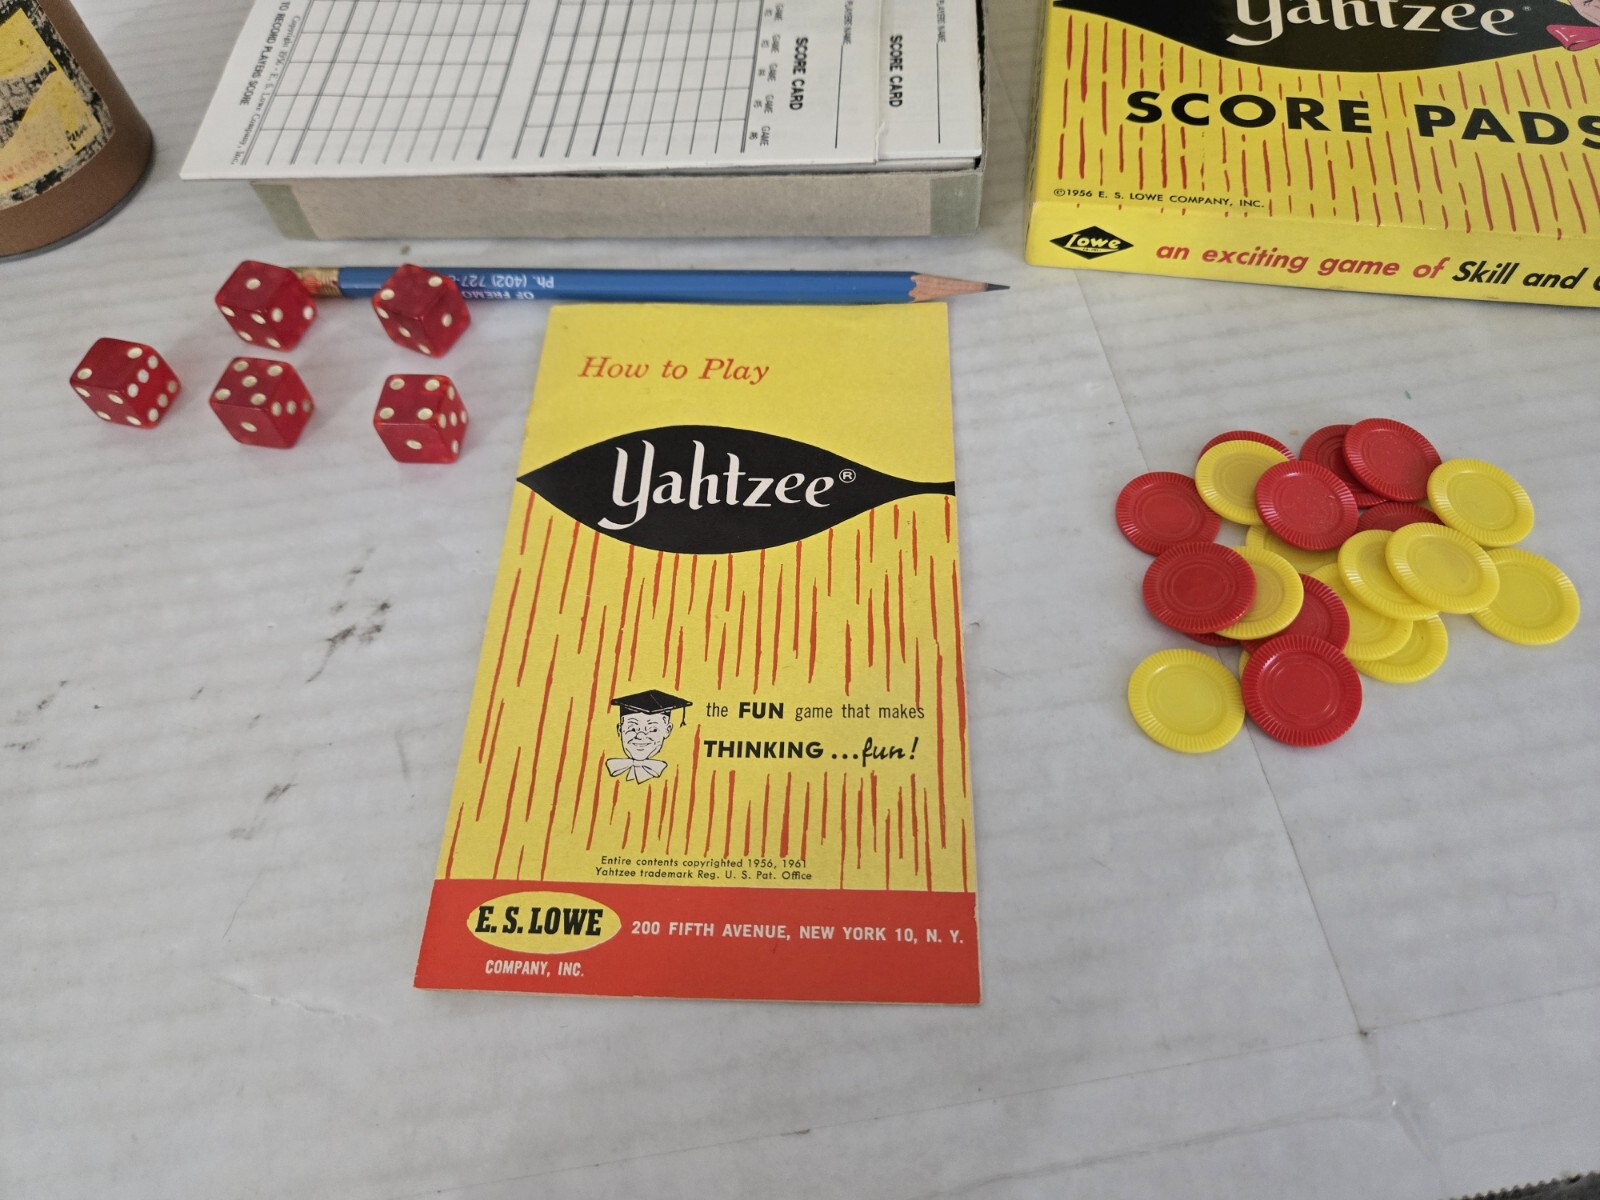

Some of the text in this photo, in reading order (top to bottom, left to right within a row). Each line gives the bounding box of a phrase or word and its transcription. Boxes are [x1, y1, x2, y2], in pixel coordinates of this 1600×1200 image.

[774, 3, 784, 21] GAME
[266, 13, 286, 44] RECORD
[771, 33, 781, 54] GAME
[767, 63, 778, 83] GAME
[789, 37, 808, 111] SCORE CARD
[889, 34, 903, 108] SCORE CARD
[239, 80, 258, 106] SCORE
[764, 94, 775, 114] GAME
[1125, 90, 1600, 150] SCORE PADS
[760, 125, 771, 146] GAME
[1098, 190, 1108, 199] E.
[1114, 191, 1124, 199] S.
[1129, 192, 1164, 202] LOWE
[1169, 195, 1233, 207] COMPANY,
[1239, 198, 1265, 208] INC.
[1065, 233, 1122, 249] Lowe
[1156, 245, 1190, 260] an
[1202, 246, 1309, 274] exciting
[1317, 257, 1400, 276] game
[1412, 256, 1451, 279] of
[1452, 260, 1520, 285] Skill
[1522, 267, 1589, 289] and
[491, 273, 527, 288] (402)
[532, 274, 555, 289] Ph.
[462, 291, 511, 299] FREMO
[577, 355, 770, 385] How to Play
[706, 702, 925, 722] the FUN game that makes
[703, 740, 824, 759] THINKING
[601, 856, 632, 866] Entire
[636, 857, 679, 867] contents
[682, 858, 743, 869] copyrighted
[748, 858, 777, 869] 1956,
[595, 867, 812, 881] Yahtzee trademark Reg. U. S. Pat. Office
[631, 920, 964, 944] 200 FIFTH AVENUE, NEW YORK 10, N. Y.
[485, 959, 584, 977] COMPANY, INC.
